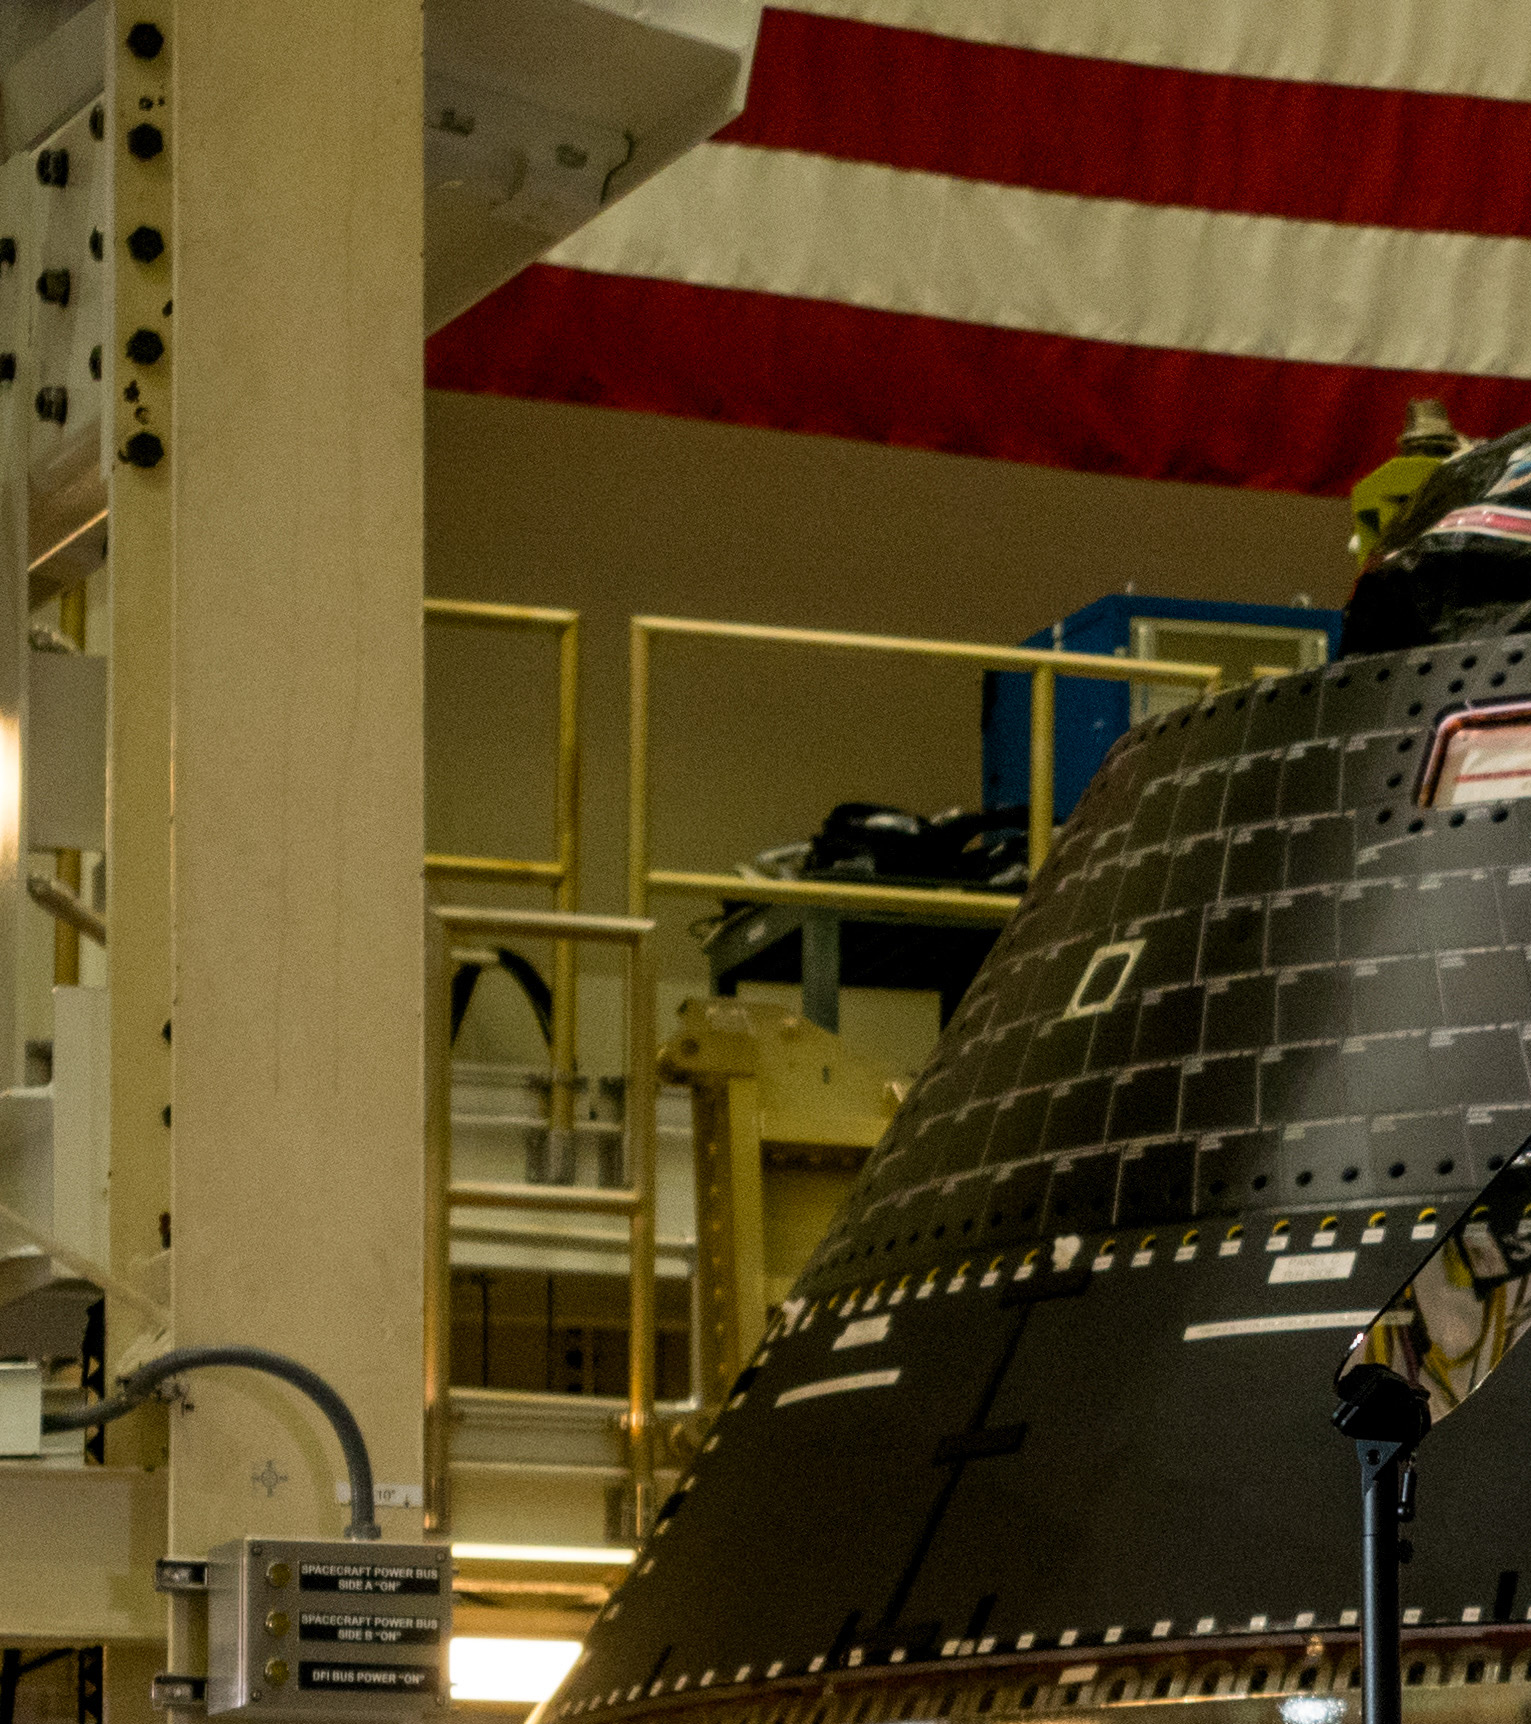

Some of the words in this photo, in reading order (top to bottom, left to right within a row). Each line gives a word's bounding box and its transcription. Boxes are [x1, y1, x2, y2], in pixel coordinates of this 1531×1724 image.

[301, 1563, 371, 1577] SPACECRAFT
[373, 1566, 414, 1579] POWER
[415, 1568, 439, 1580] BUS
[337, 1578, 363, 1591] SIDE
[364, 1580, 374, 1591] A
[301, 1613, 371, 1626] SPACECRAFT
[373, 1616, 414, 1628] POWER
[415, 1618, 439, 1630] BUS
[337, 1628, 363, 1641] SIDE
[364, 1630, 374, 1641] B
[312, 1669, 330, 1682] DFI
[331, 1670, 355, 1683] BUS
[356, 1671, 397, 1684] POWER
